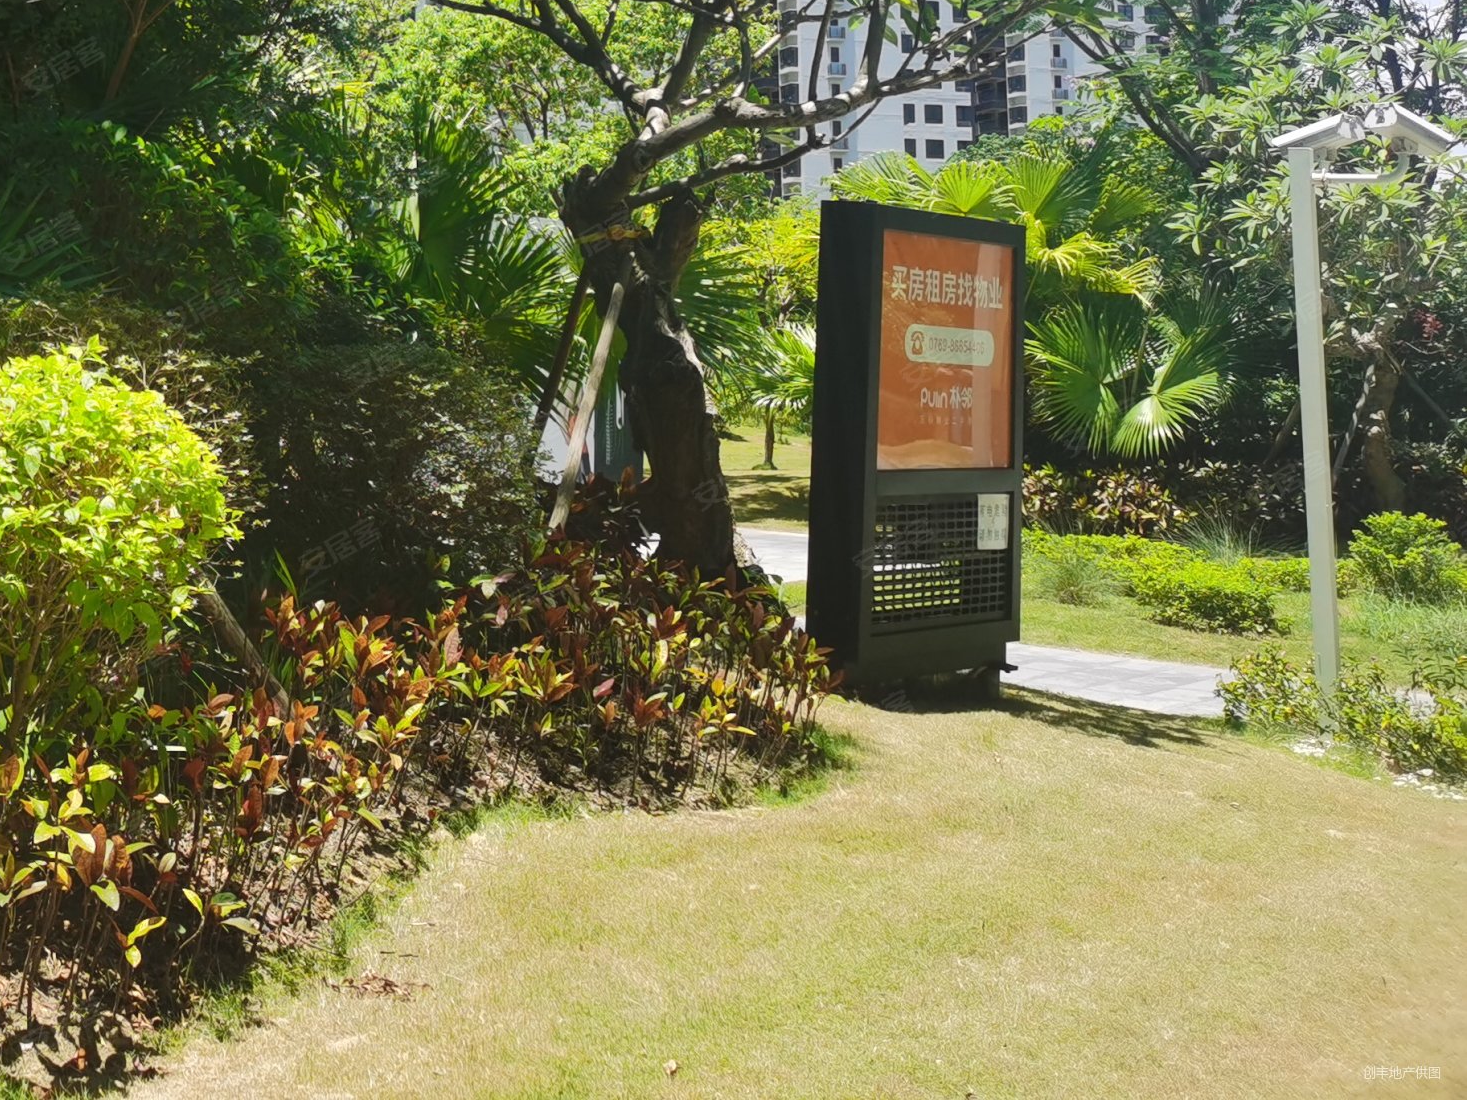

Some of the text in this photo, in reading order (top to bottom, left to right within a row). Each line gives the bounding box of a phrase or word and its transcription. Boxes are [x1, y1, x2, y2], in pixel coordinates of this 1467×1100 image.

[891, 265, 1004, 310] 买房租房找物业
[949, 384, 973, 410] 朴邻
